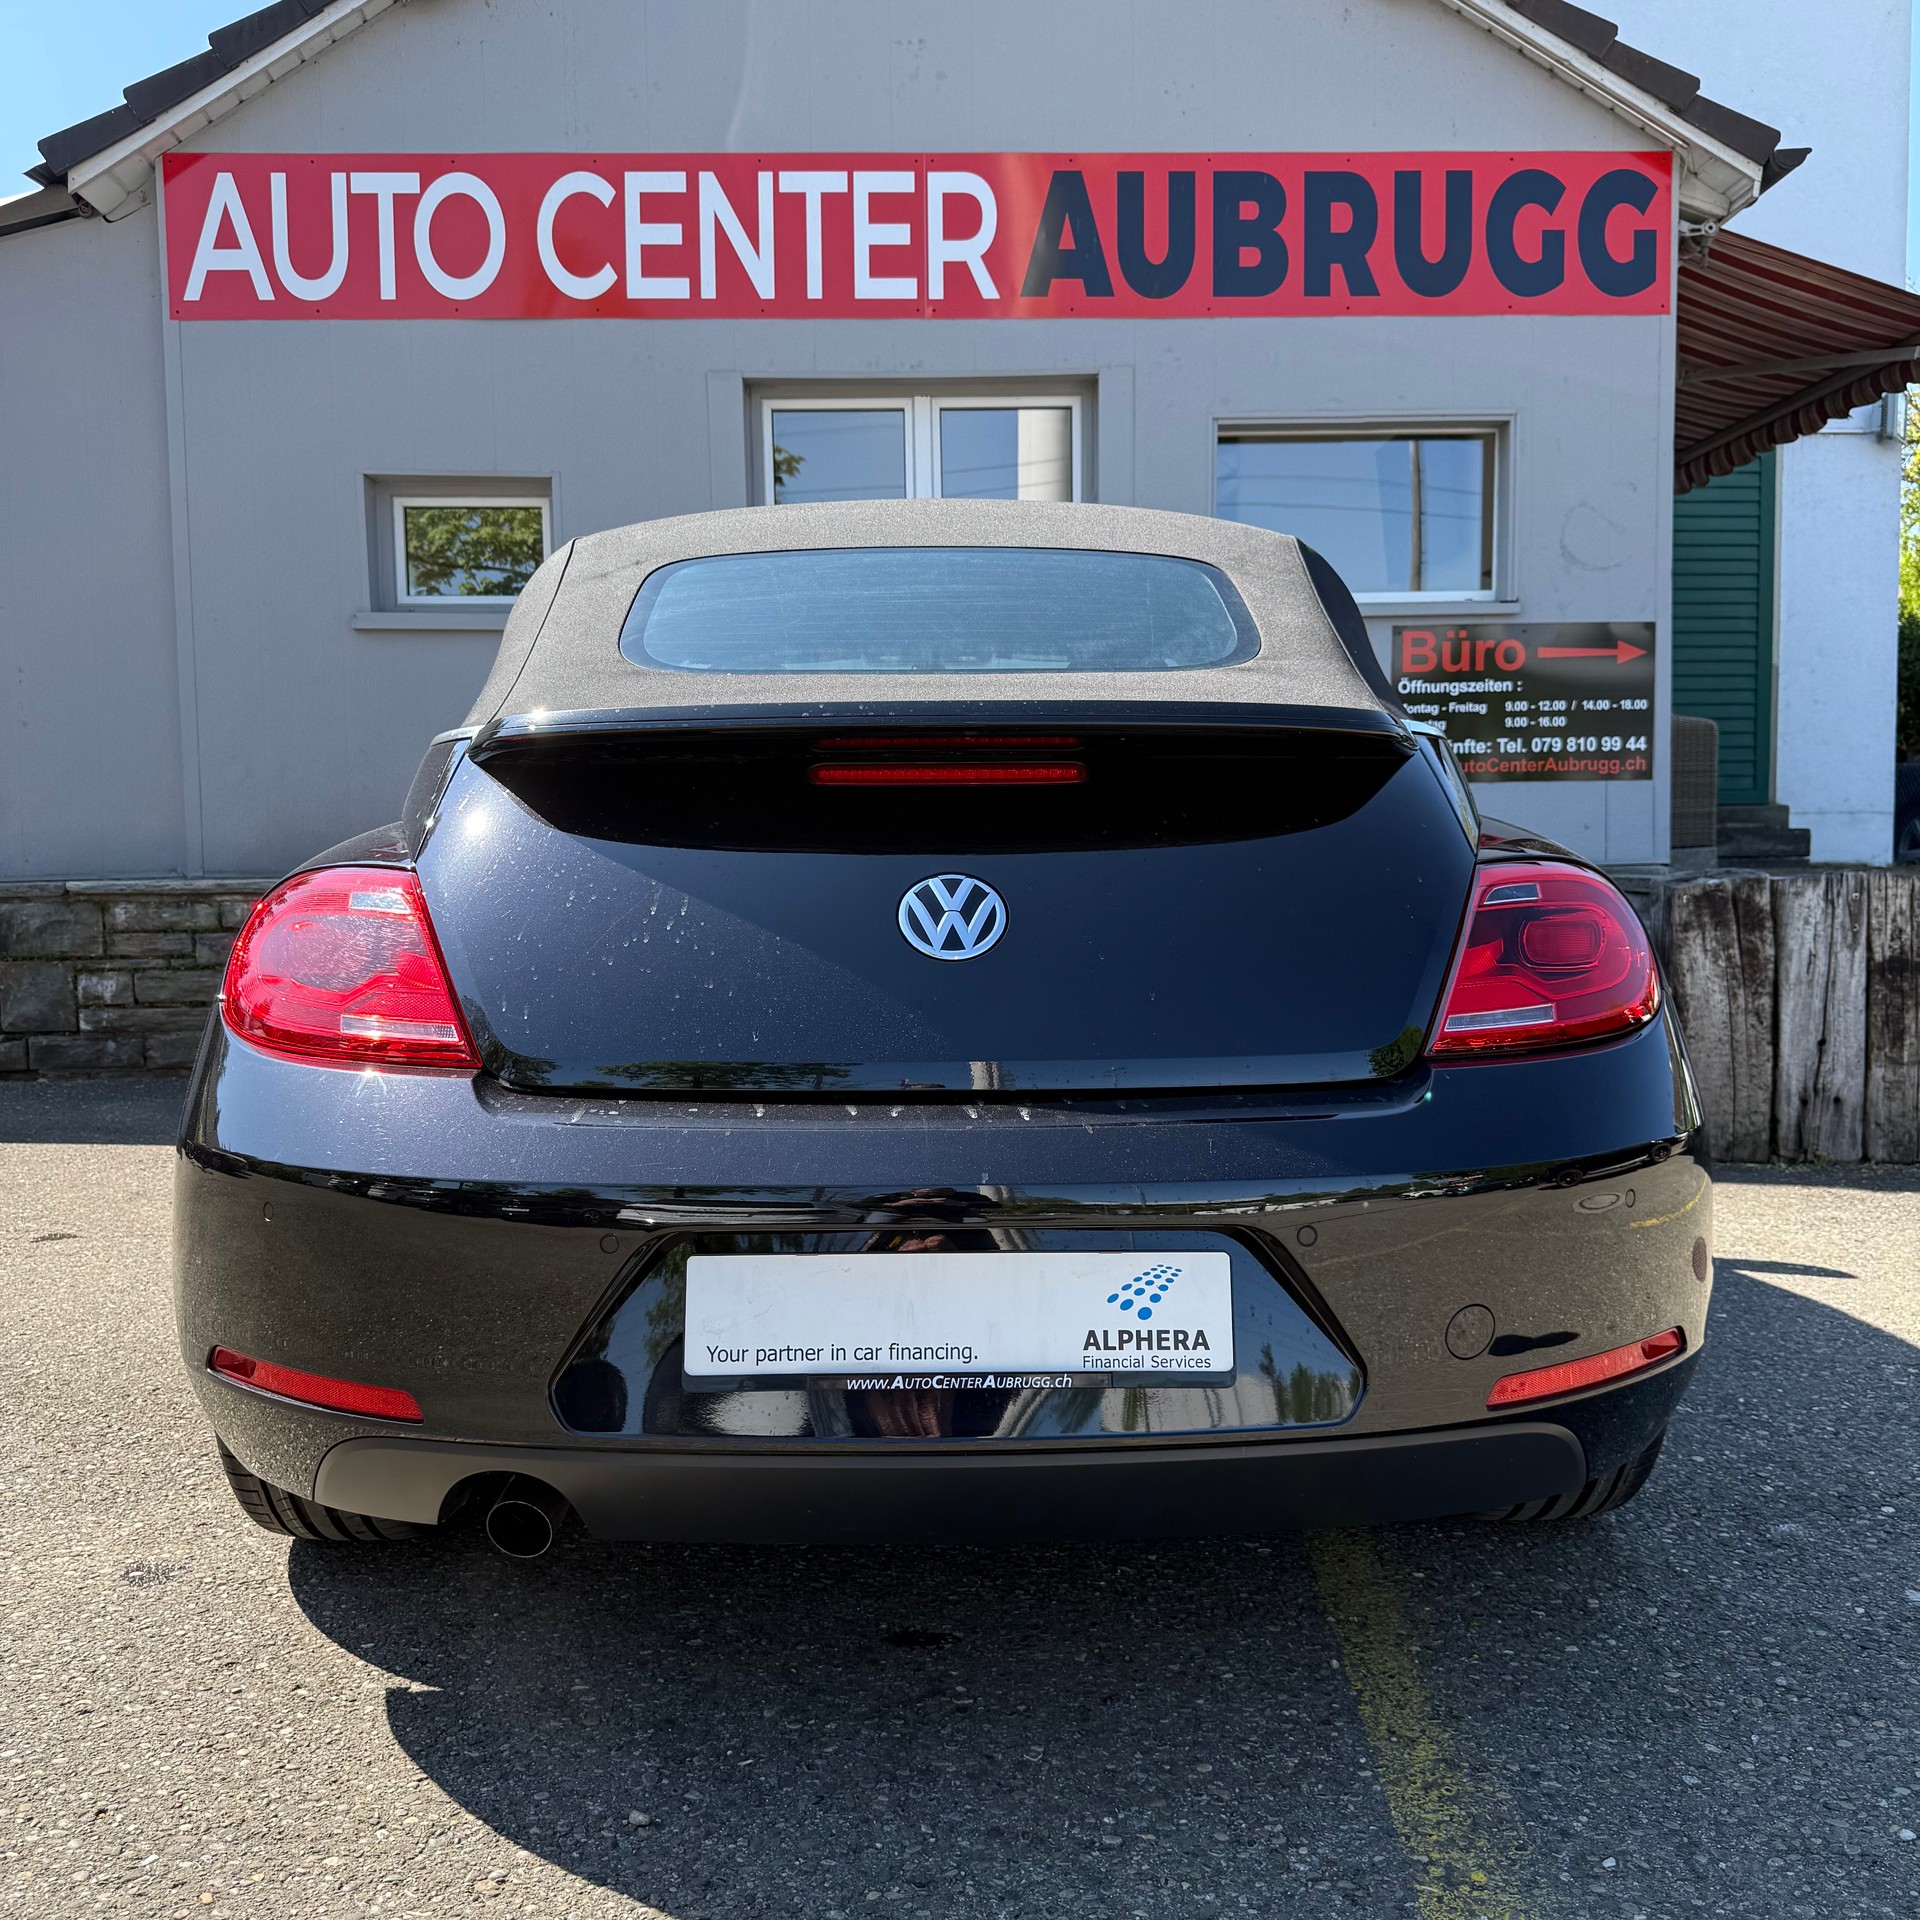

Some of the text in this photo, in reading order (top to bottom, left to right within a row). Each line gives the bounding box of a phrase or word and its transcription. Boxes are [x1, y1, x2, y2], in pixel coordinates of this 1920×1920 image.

[183, 168, 1659, 302] AUTO CENTER AUBRUGG
[1401, 630, 1526, 673] Büro
[1398, 677, 1513, 696] Öffnungszeiten
[1449, 702, 1488, 714] Freitag
[1504, 701, 1528, 712] 9.00
[1537, 701, 1566, 711] 12.00
[1582, 699, 1610, 711] 14.00
[1620, 699, 1648, 710] 18.00
[1504, 717, 1528, 728] 9.00
[1537, 717, 1567, 728] 16.00
[1497, 738, 1527, 753] Tel.
[1531, 738, 1562, 752] 079
[1566, 737, 1597, 752] 810
[1601, 737, 1621, 751] 99
[1625, 736, 1647, 751] 44
[1083, 1329, 1211, 1351] ALPHERA
[706, 1343, 979, 1366] Your partner in car financing.
[1082, 1353, 1212, 1369] Financial Services
